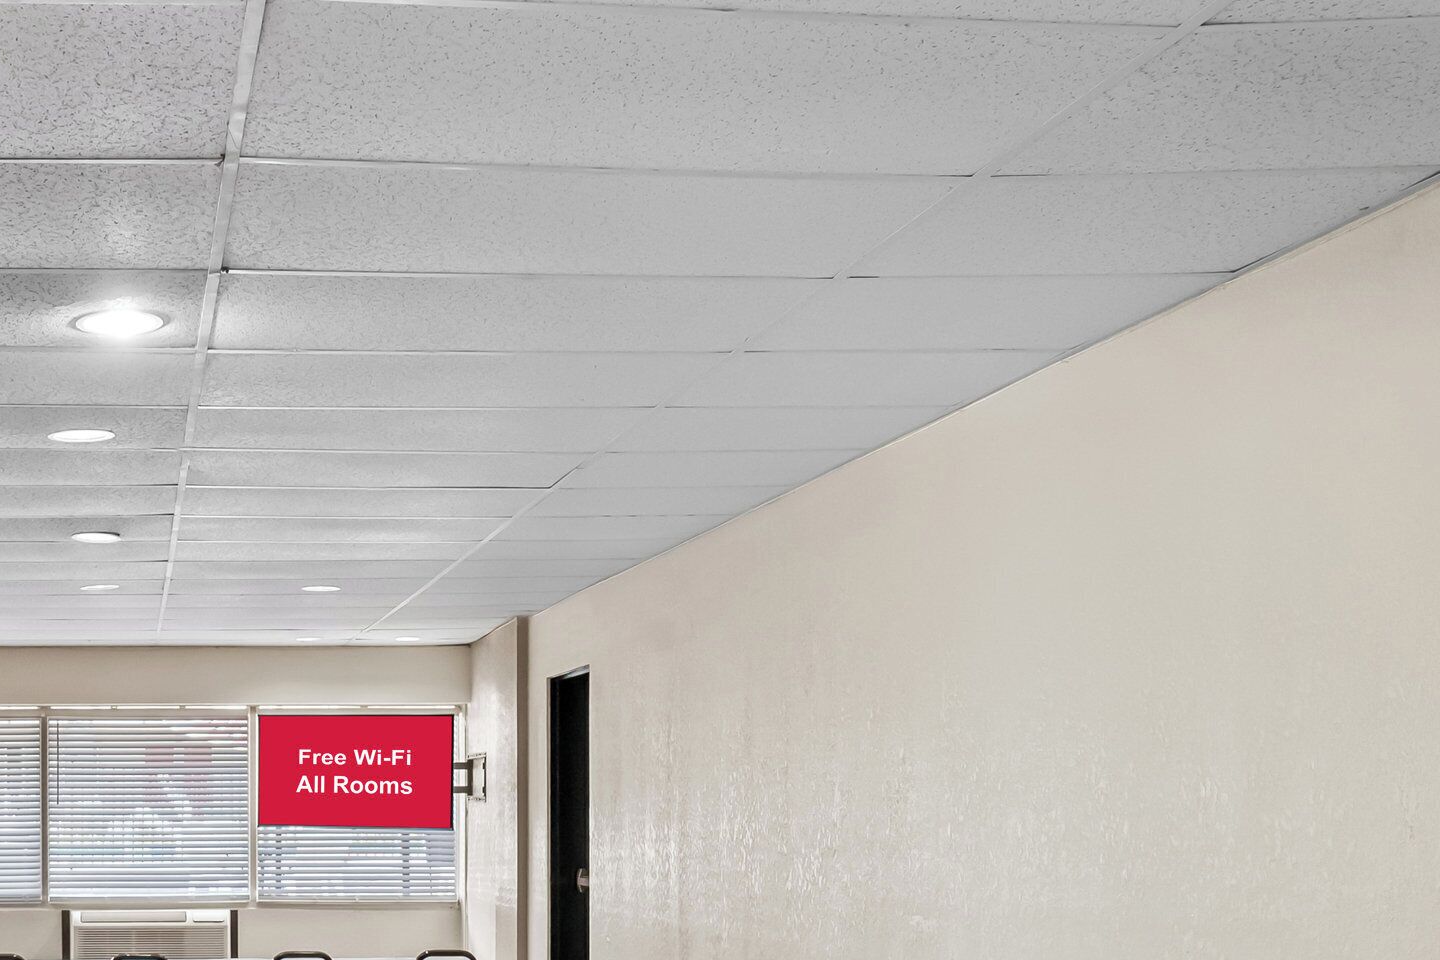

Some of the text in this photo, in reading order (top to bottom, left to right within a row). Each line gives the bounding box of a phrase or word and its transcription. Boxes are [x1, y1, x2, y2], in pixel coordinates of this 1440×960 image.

[298, 748, 412, 766] Free Wi-Fi
[295, 775, 413, 795] All Rooms
